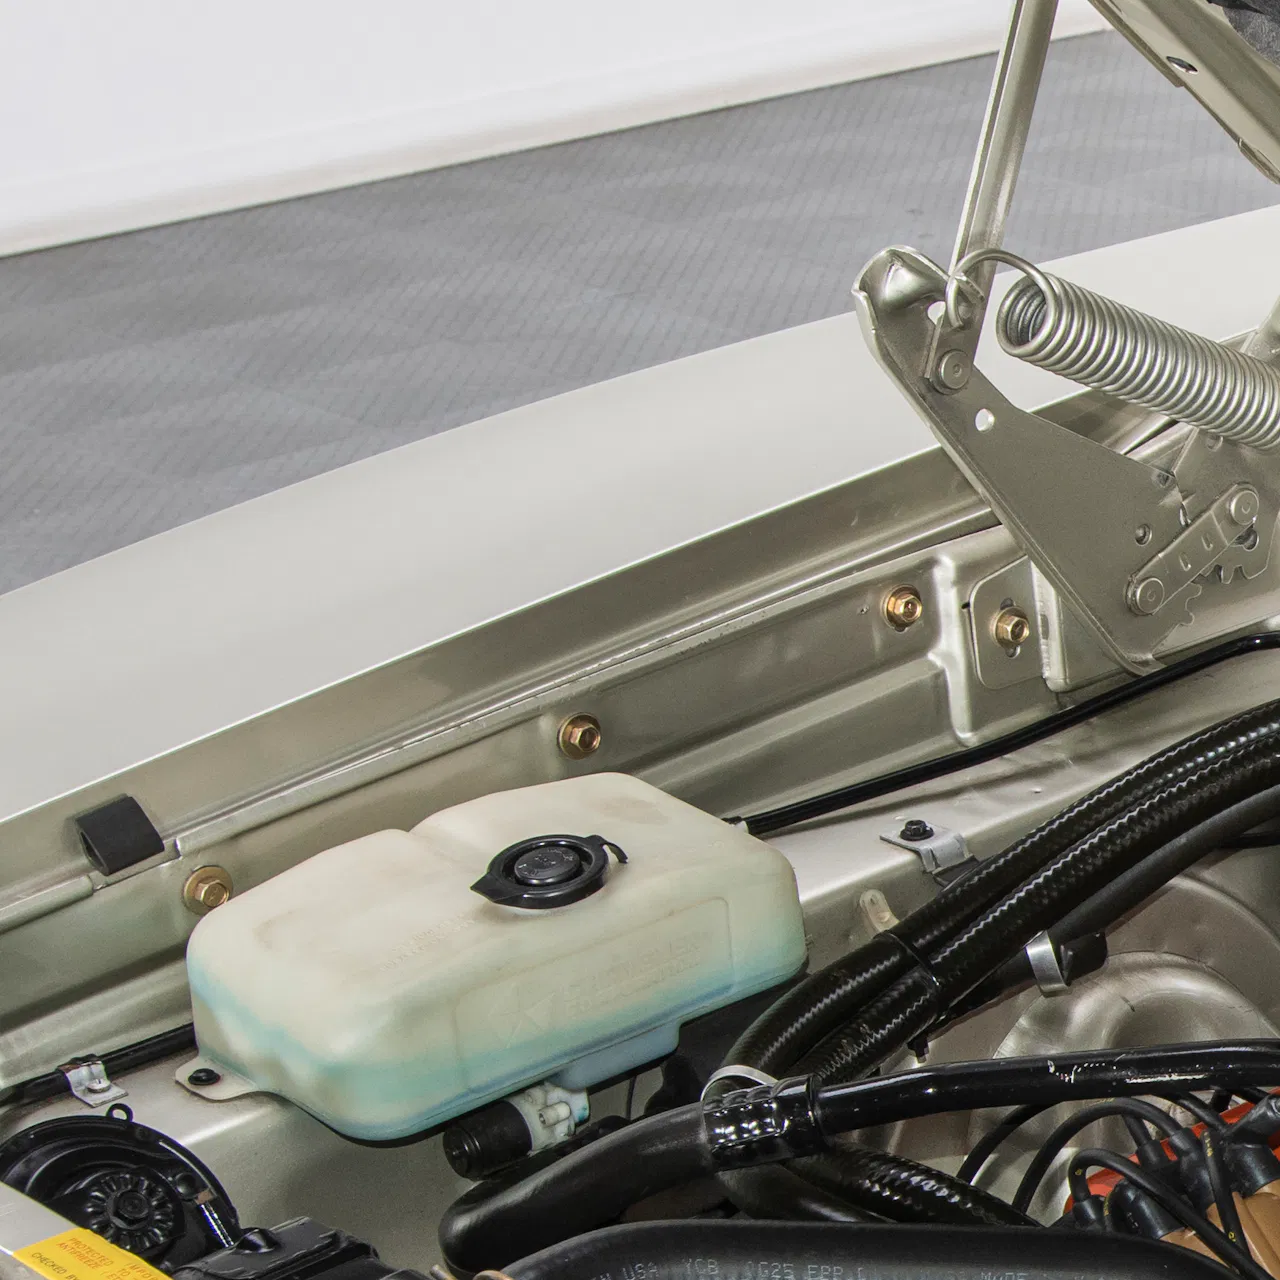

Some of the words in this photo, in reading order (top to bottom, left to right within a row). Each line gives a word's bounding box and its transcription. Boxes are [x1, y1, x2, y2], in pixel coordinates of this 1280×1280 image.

[28, 1251, 68, 1275] CHECKED
[53, 1240, 103, 1271] ANTIFREEZE
[64, 1236, 114, 1267] PROTECTED
[114, 1268, 131, 1277] TO
